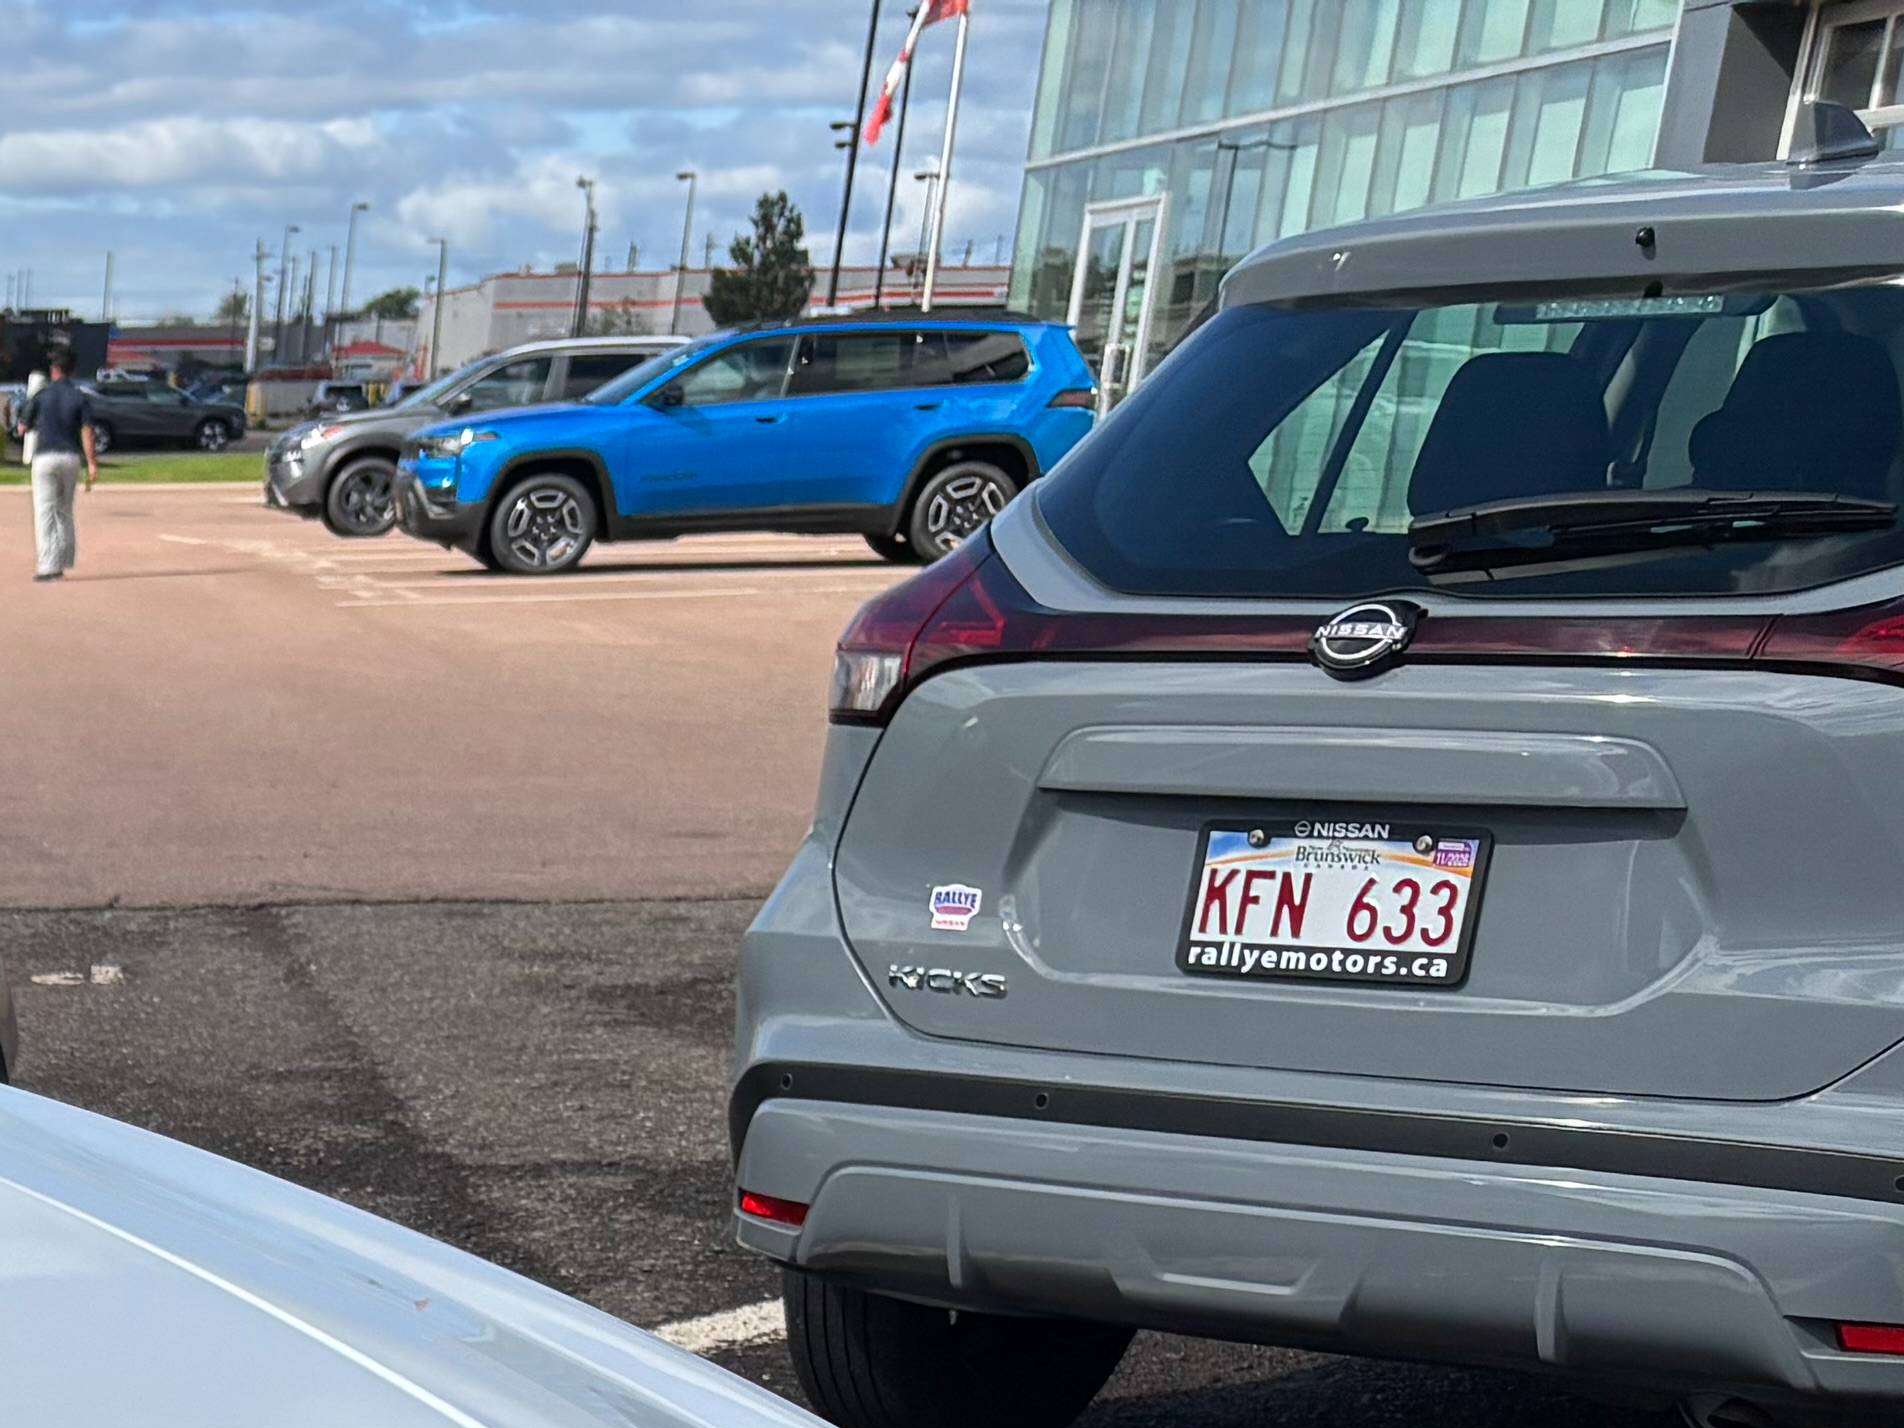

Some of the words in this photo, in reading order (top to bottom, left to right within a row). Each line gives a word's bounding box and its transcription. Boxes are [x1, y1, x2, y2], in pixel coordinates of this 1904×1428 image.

[1314, 622, 1408, 640] NISSAN
[1313, 822, 1390, 839] NISSAN
[1295, 845, 1381, 865] Brunswick
[935, 890, 977, 909] RALLYE
[1198, 868, 1313, 939] KFN
[1346, 877, 1459, 947] 633
[1187, 942, 1448, 977] rallyemotors.ca
[888, 964, 1008, 998] KICKS
